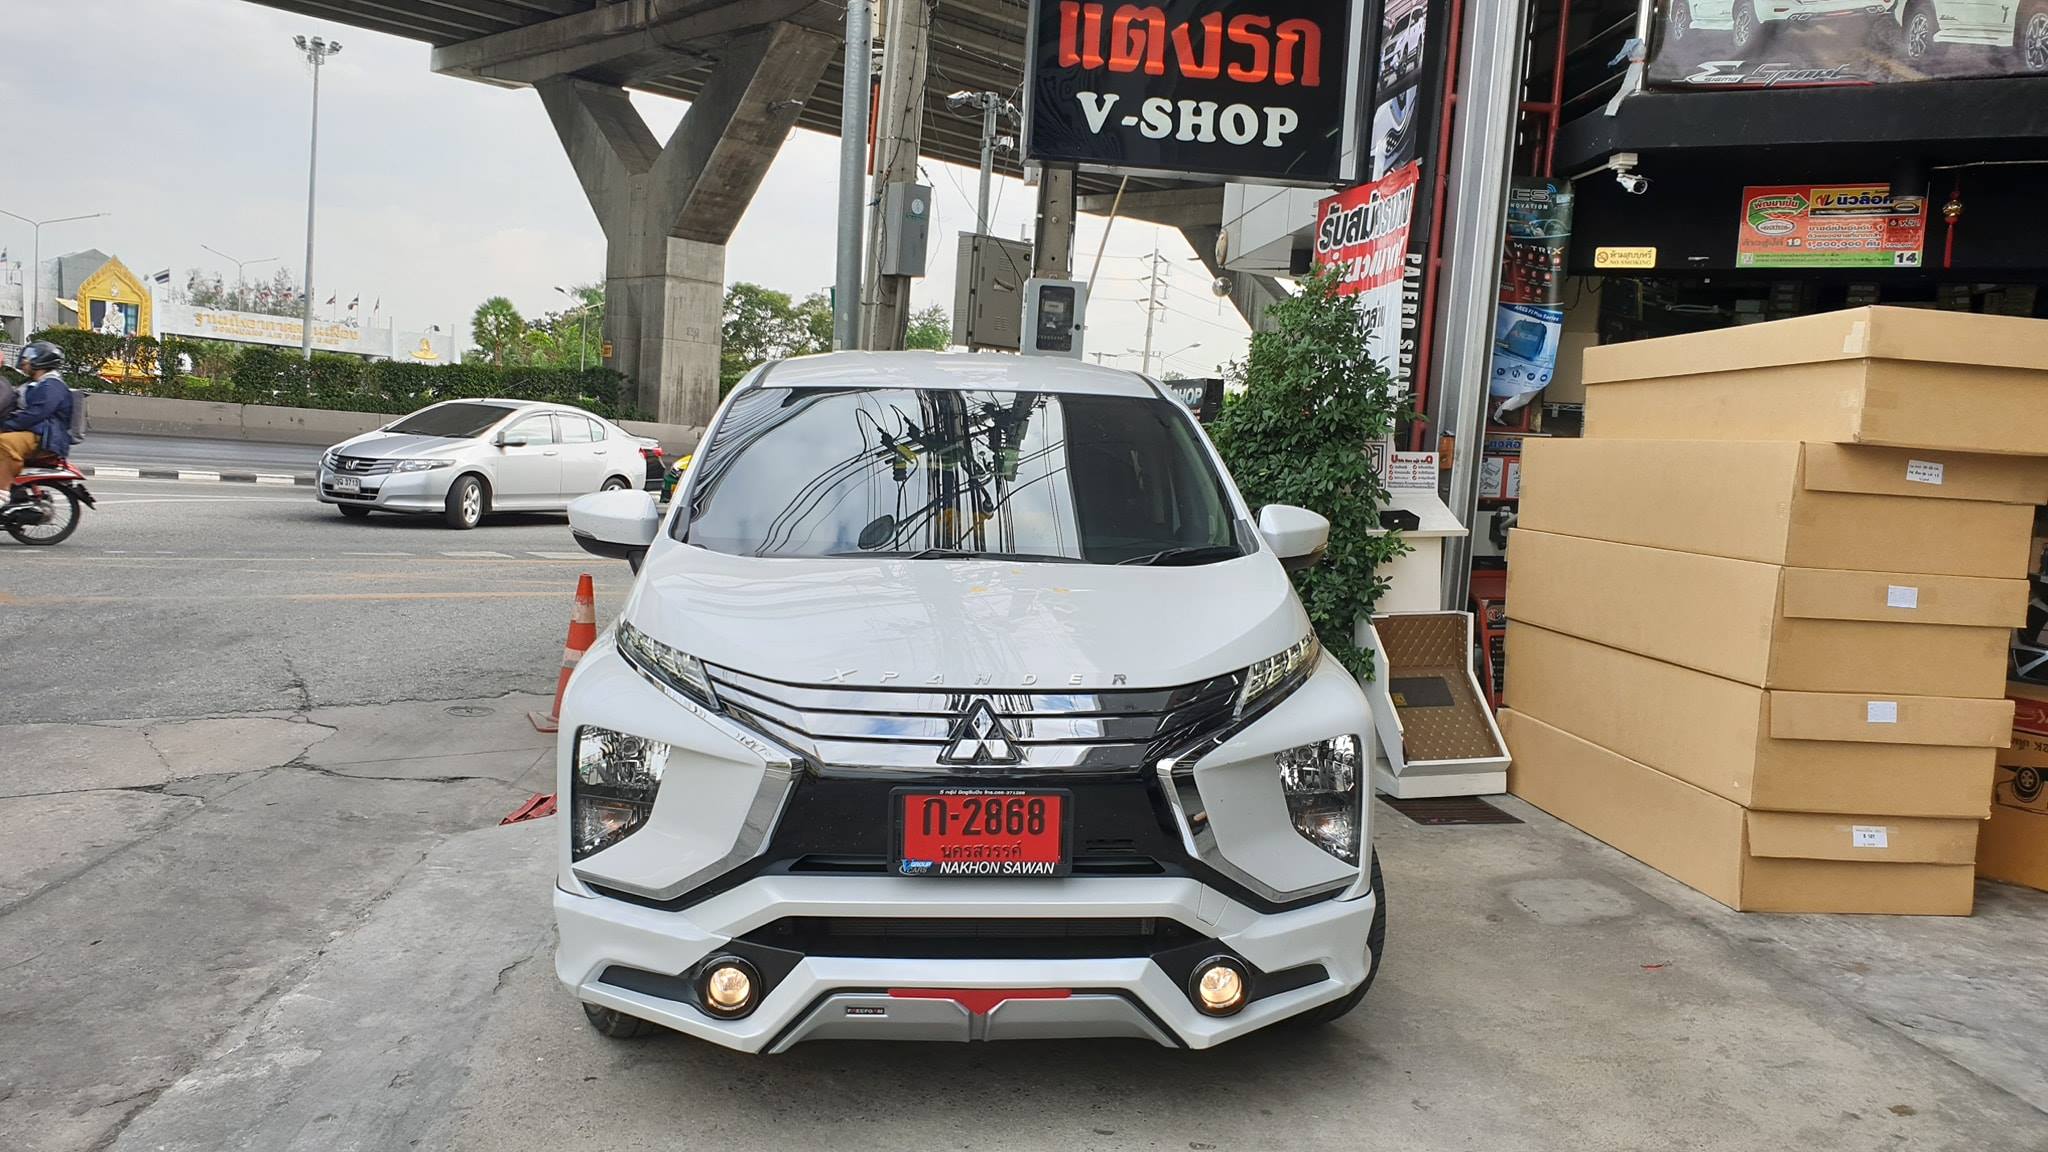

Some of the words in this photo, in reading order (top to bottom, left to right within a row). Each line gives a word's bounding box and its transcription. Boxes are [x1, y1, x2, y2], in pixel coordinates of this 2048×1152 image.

[1076, 91, 1299, 147] V-SHOP
[1510, 187, 1552, 203] ES
[1896, 252, 1918, 264] 14
[1401, 253, 1423, 329] PAJERO
[821, 668, 1127, 686] XPANDER
[922, 797, 1046, 836] ก-2868
[940, 840, 1022, 858] นครสวรรค์
[939, 861, 1001, 874] NAKHON
[1002, 861, 1055, 874] SAWAN
